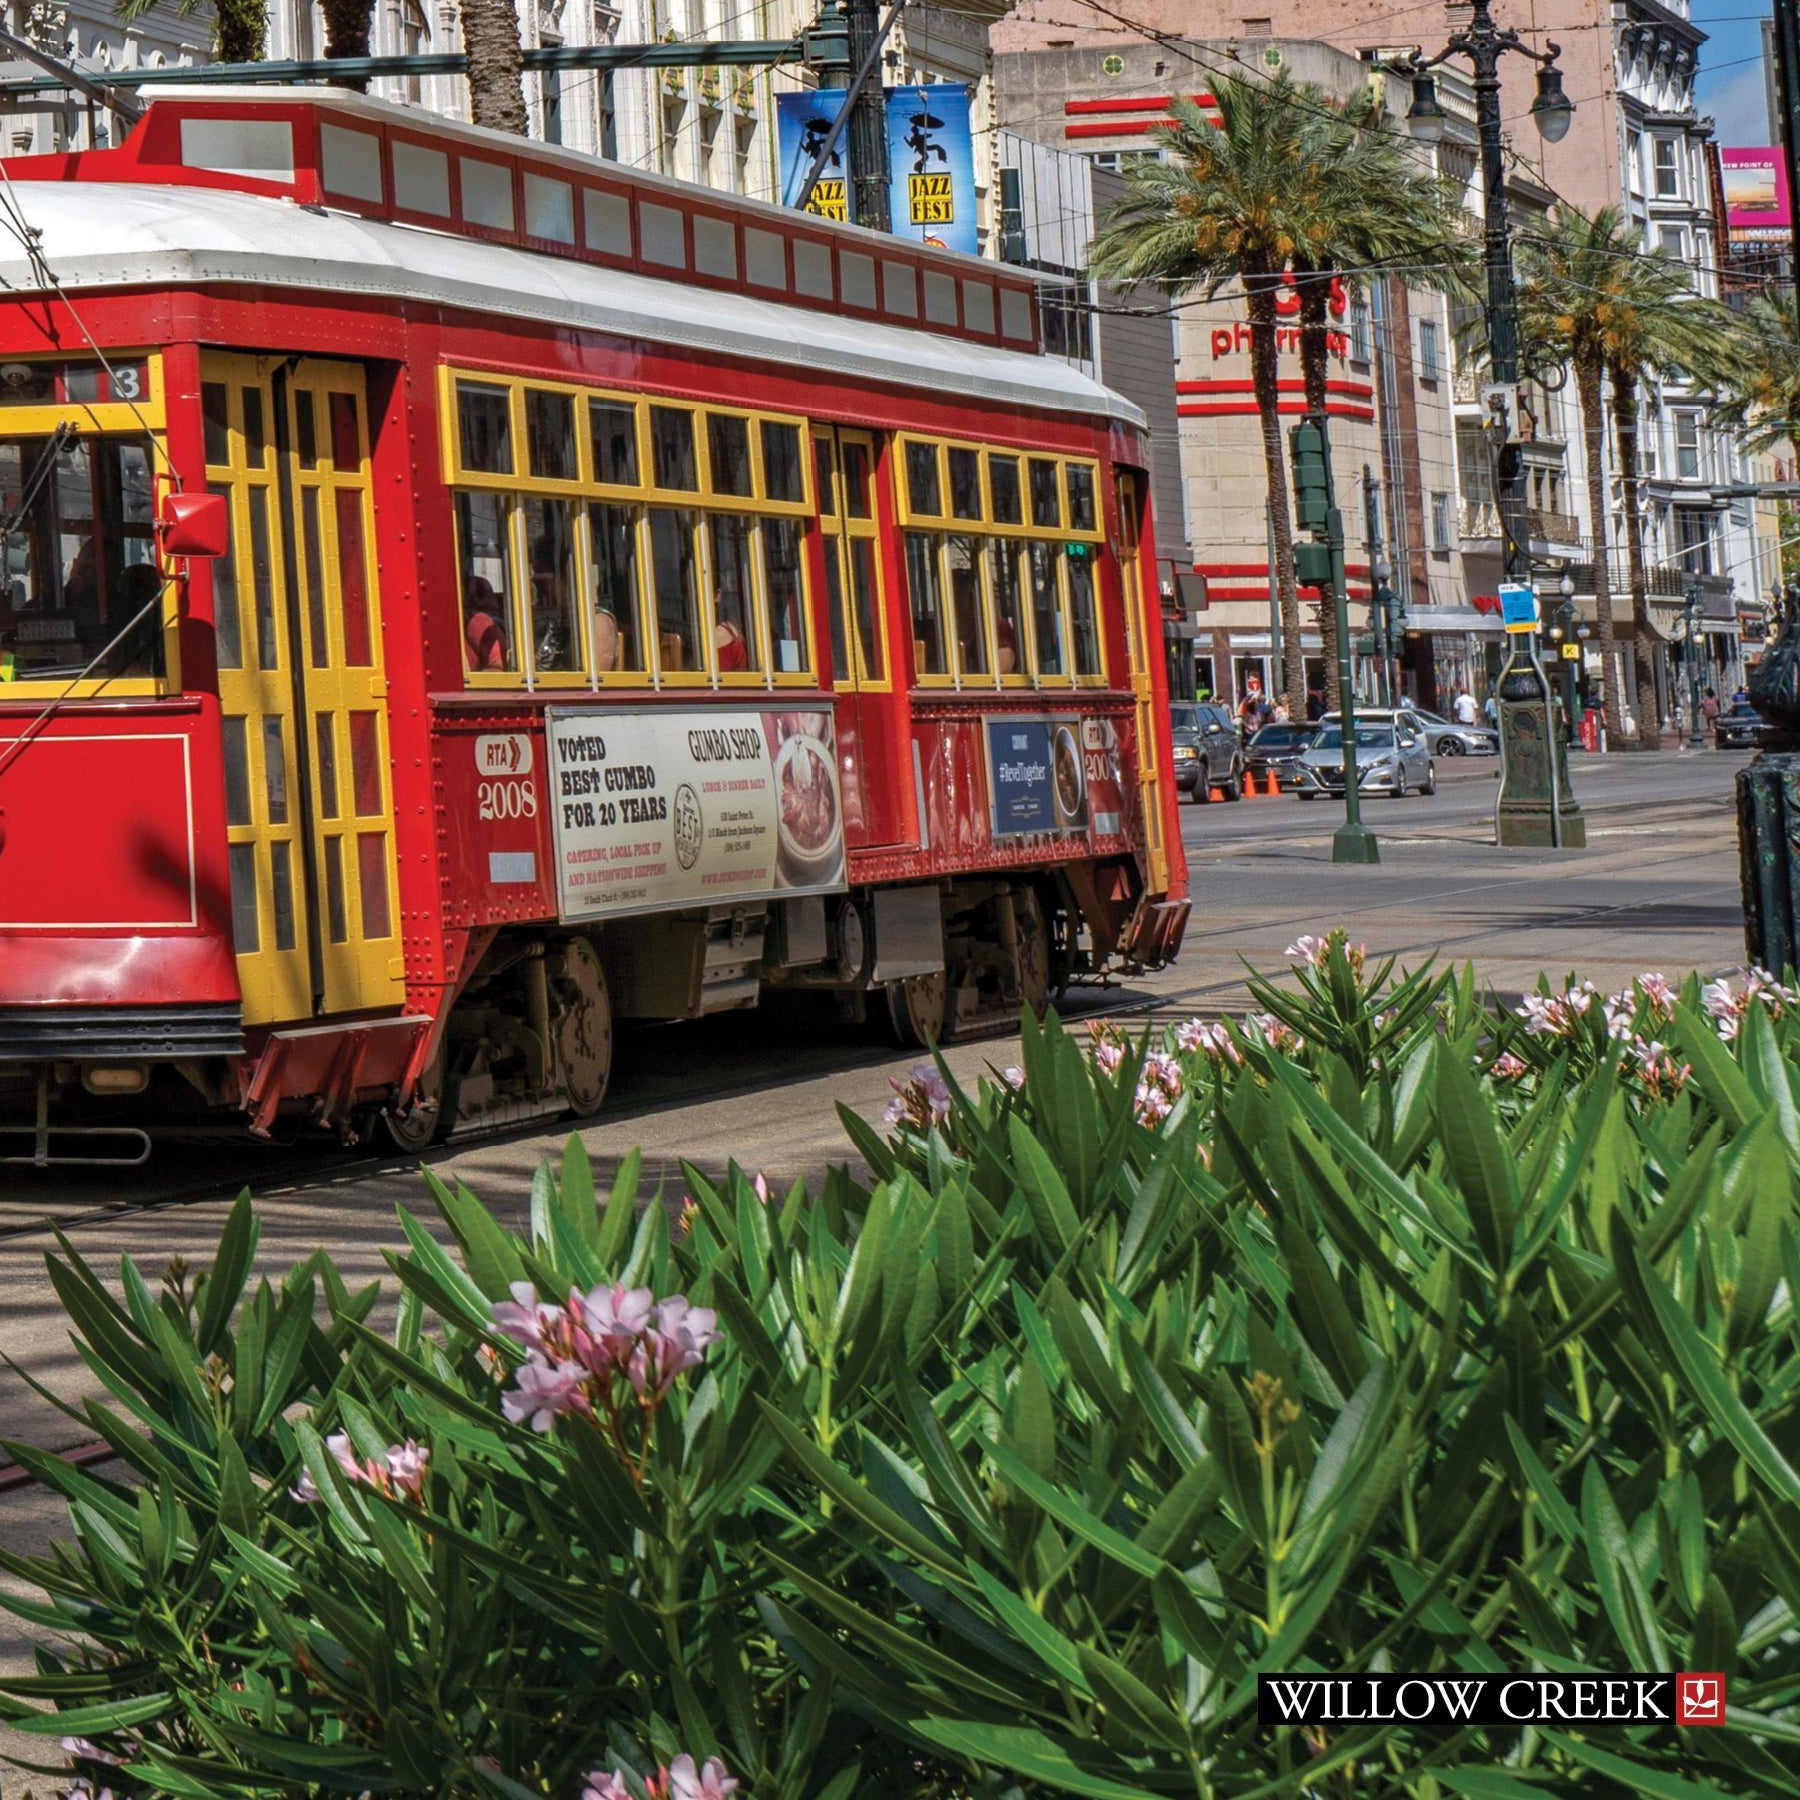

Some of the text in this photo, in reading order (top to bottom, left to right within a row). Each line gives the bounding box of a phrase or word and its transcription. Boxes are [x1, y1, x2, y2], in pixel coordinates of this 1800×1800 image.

[812, 181, 845, 201] AZZ
[911, 177, 951, 199] JAZZ
[912, 201, 953, 220] FEST
[115, 367, 140, 399] 3
[487, 743, 508, 766] RTA
[558, 735, 606, 763] VOTED
[688, 728, 761, 762] GUMBO SHOP
[560, 765, 655, 796] BEST GUMBO
[999, 761, 1046, 788] #RevelTogether
[478, 780, 537, 821] 2008
[563, 796, 667, 829] FOR 20 YEARS
[567, 847, 609, 864] CATERING,
[610, 845, 632, 859] LOCAL
[634, 843, 651, 857] PICK
[652, 841, 662, 855] UP
[568, 863, 666, 887] AND NATIONWIDE SHIPPING
